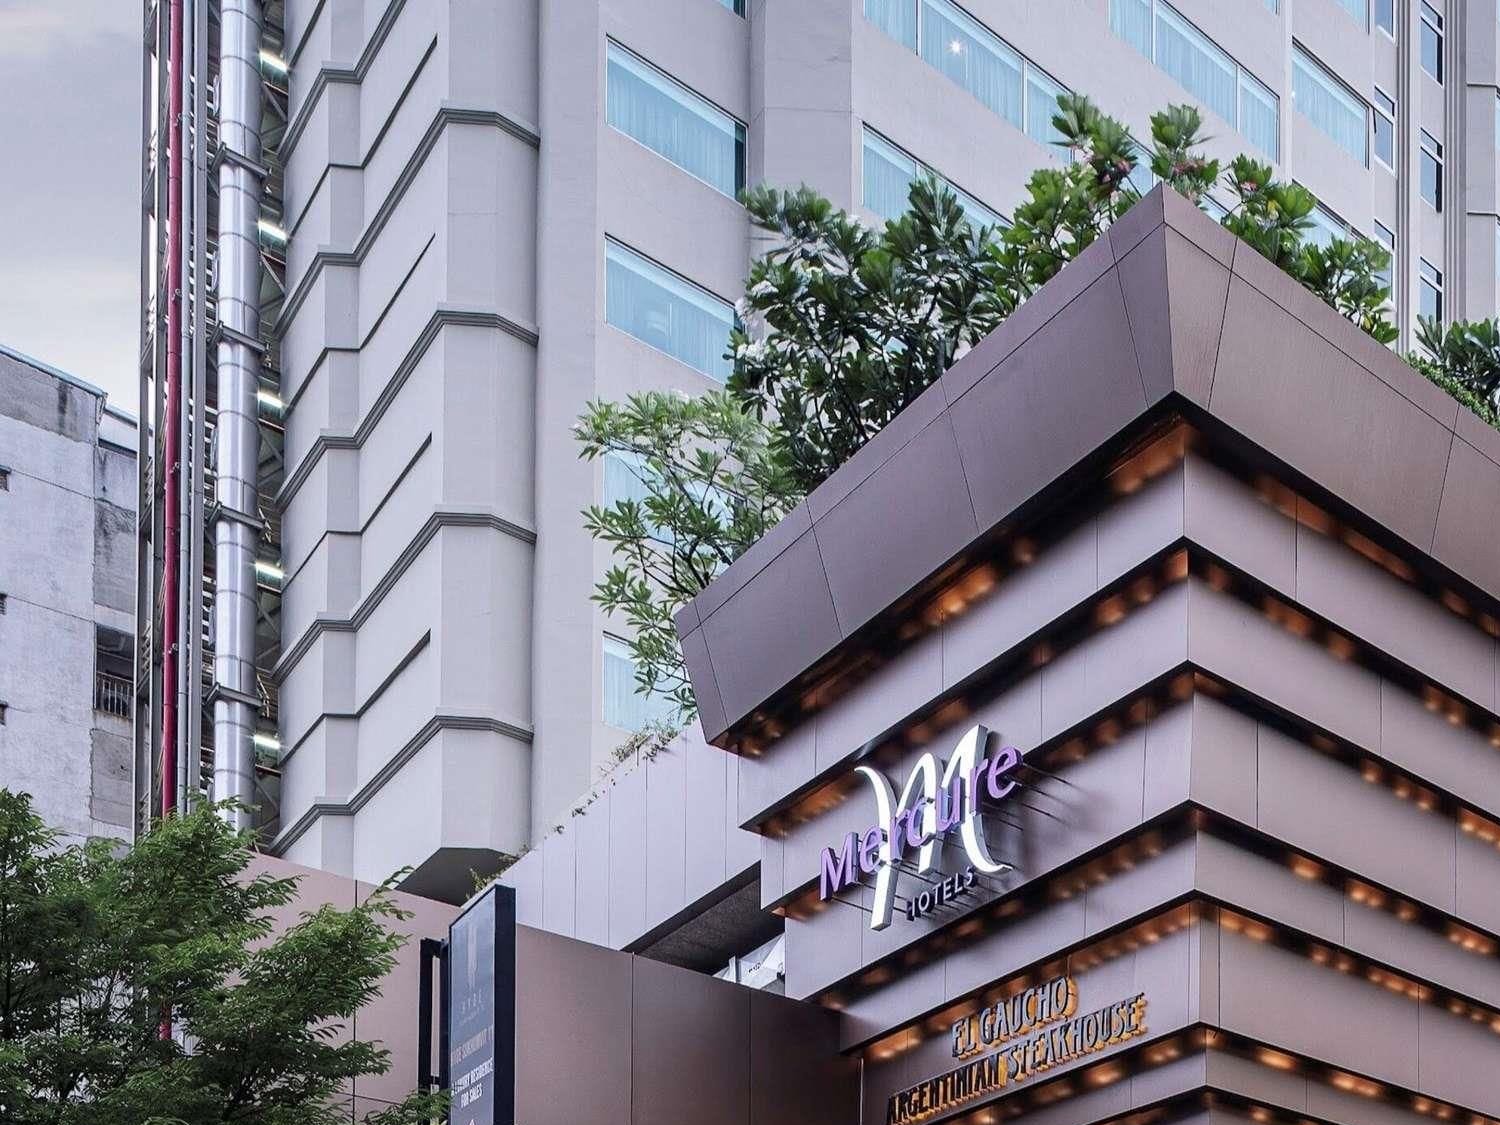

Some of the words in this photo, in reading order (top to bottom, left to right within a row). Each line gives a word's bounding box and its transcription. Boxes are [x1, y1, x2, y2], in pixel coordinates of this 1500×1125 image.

[820, 744, 1024, 901] Mercure
[907, 866, 976, 921] HOTELS
[952, 1018, 978, 1059] EL
[979, 976, 1075, 1047] GAUCHO
[1006, 992, 1146, 1081] STEAKHOUSE
